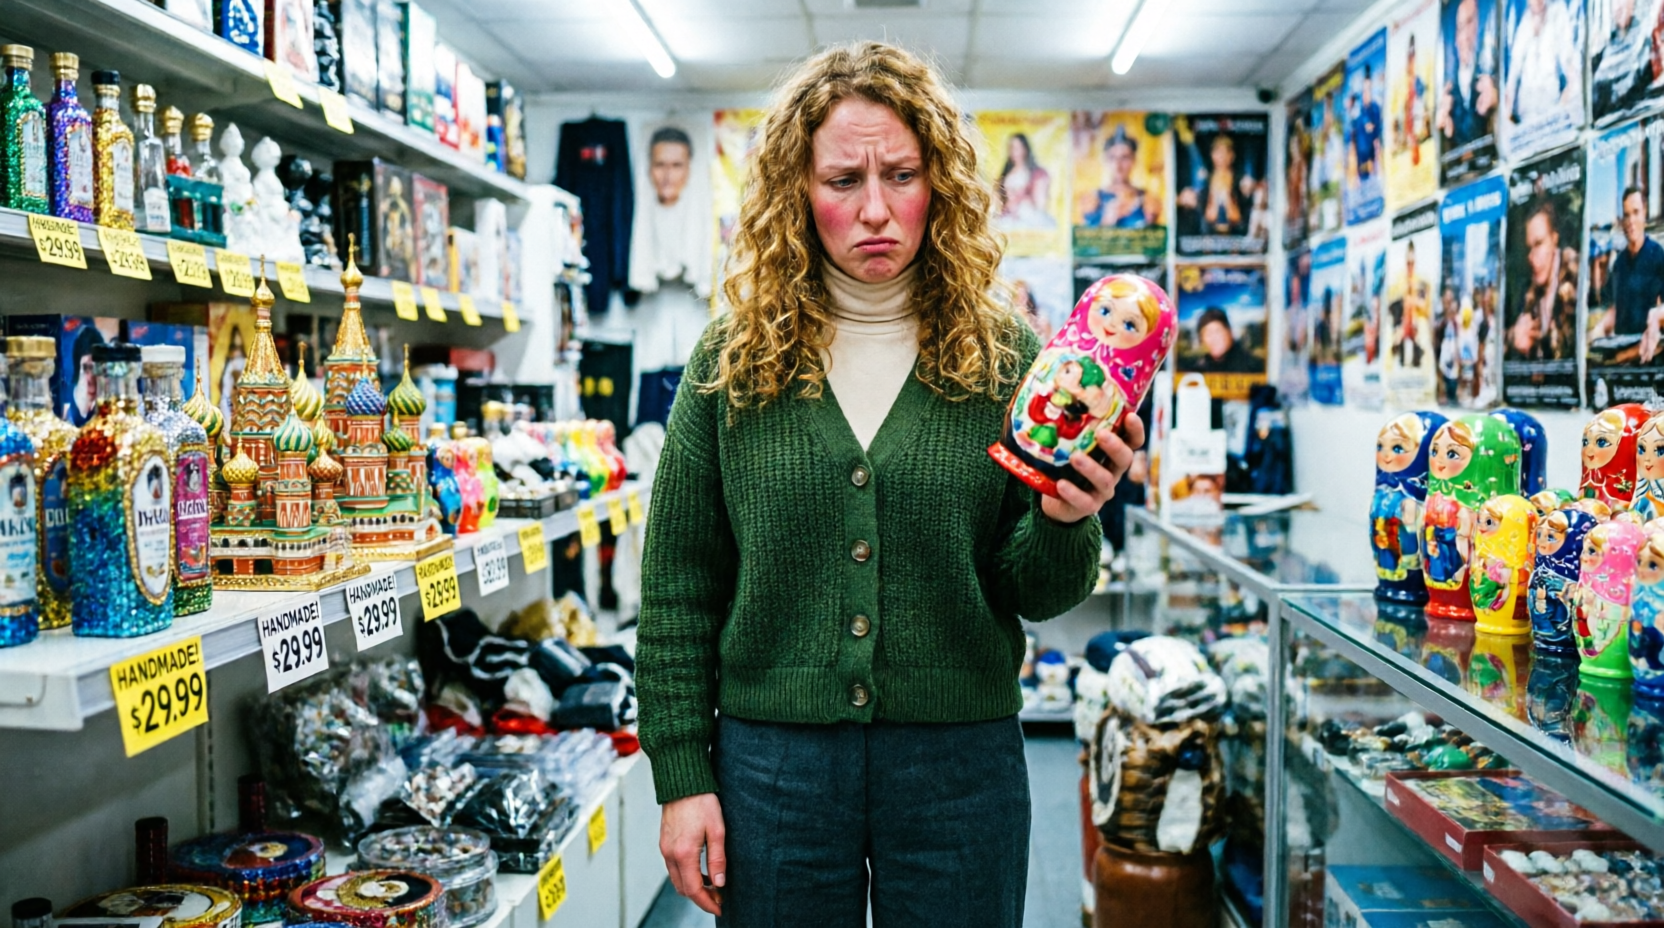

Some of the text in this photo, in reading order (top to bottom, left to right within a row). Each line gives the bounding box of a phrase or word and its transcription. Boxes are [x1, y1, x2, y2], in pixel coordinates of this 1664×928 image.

[39, 235, 81, 261] $29.99
[349, 575, 396, 604] HANDMADE!
[262, 601, 319, 638] HANDMADE!
[358, 596, 397, 638] $29.99
[116, 643, 200, 691] HANDMADE!
[272, 626, 323, 674] $29.99
[131, 672, 203, 735] $29.99
